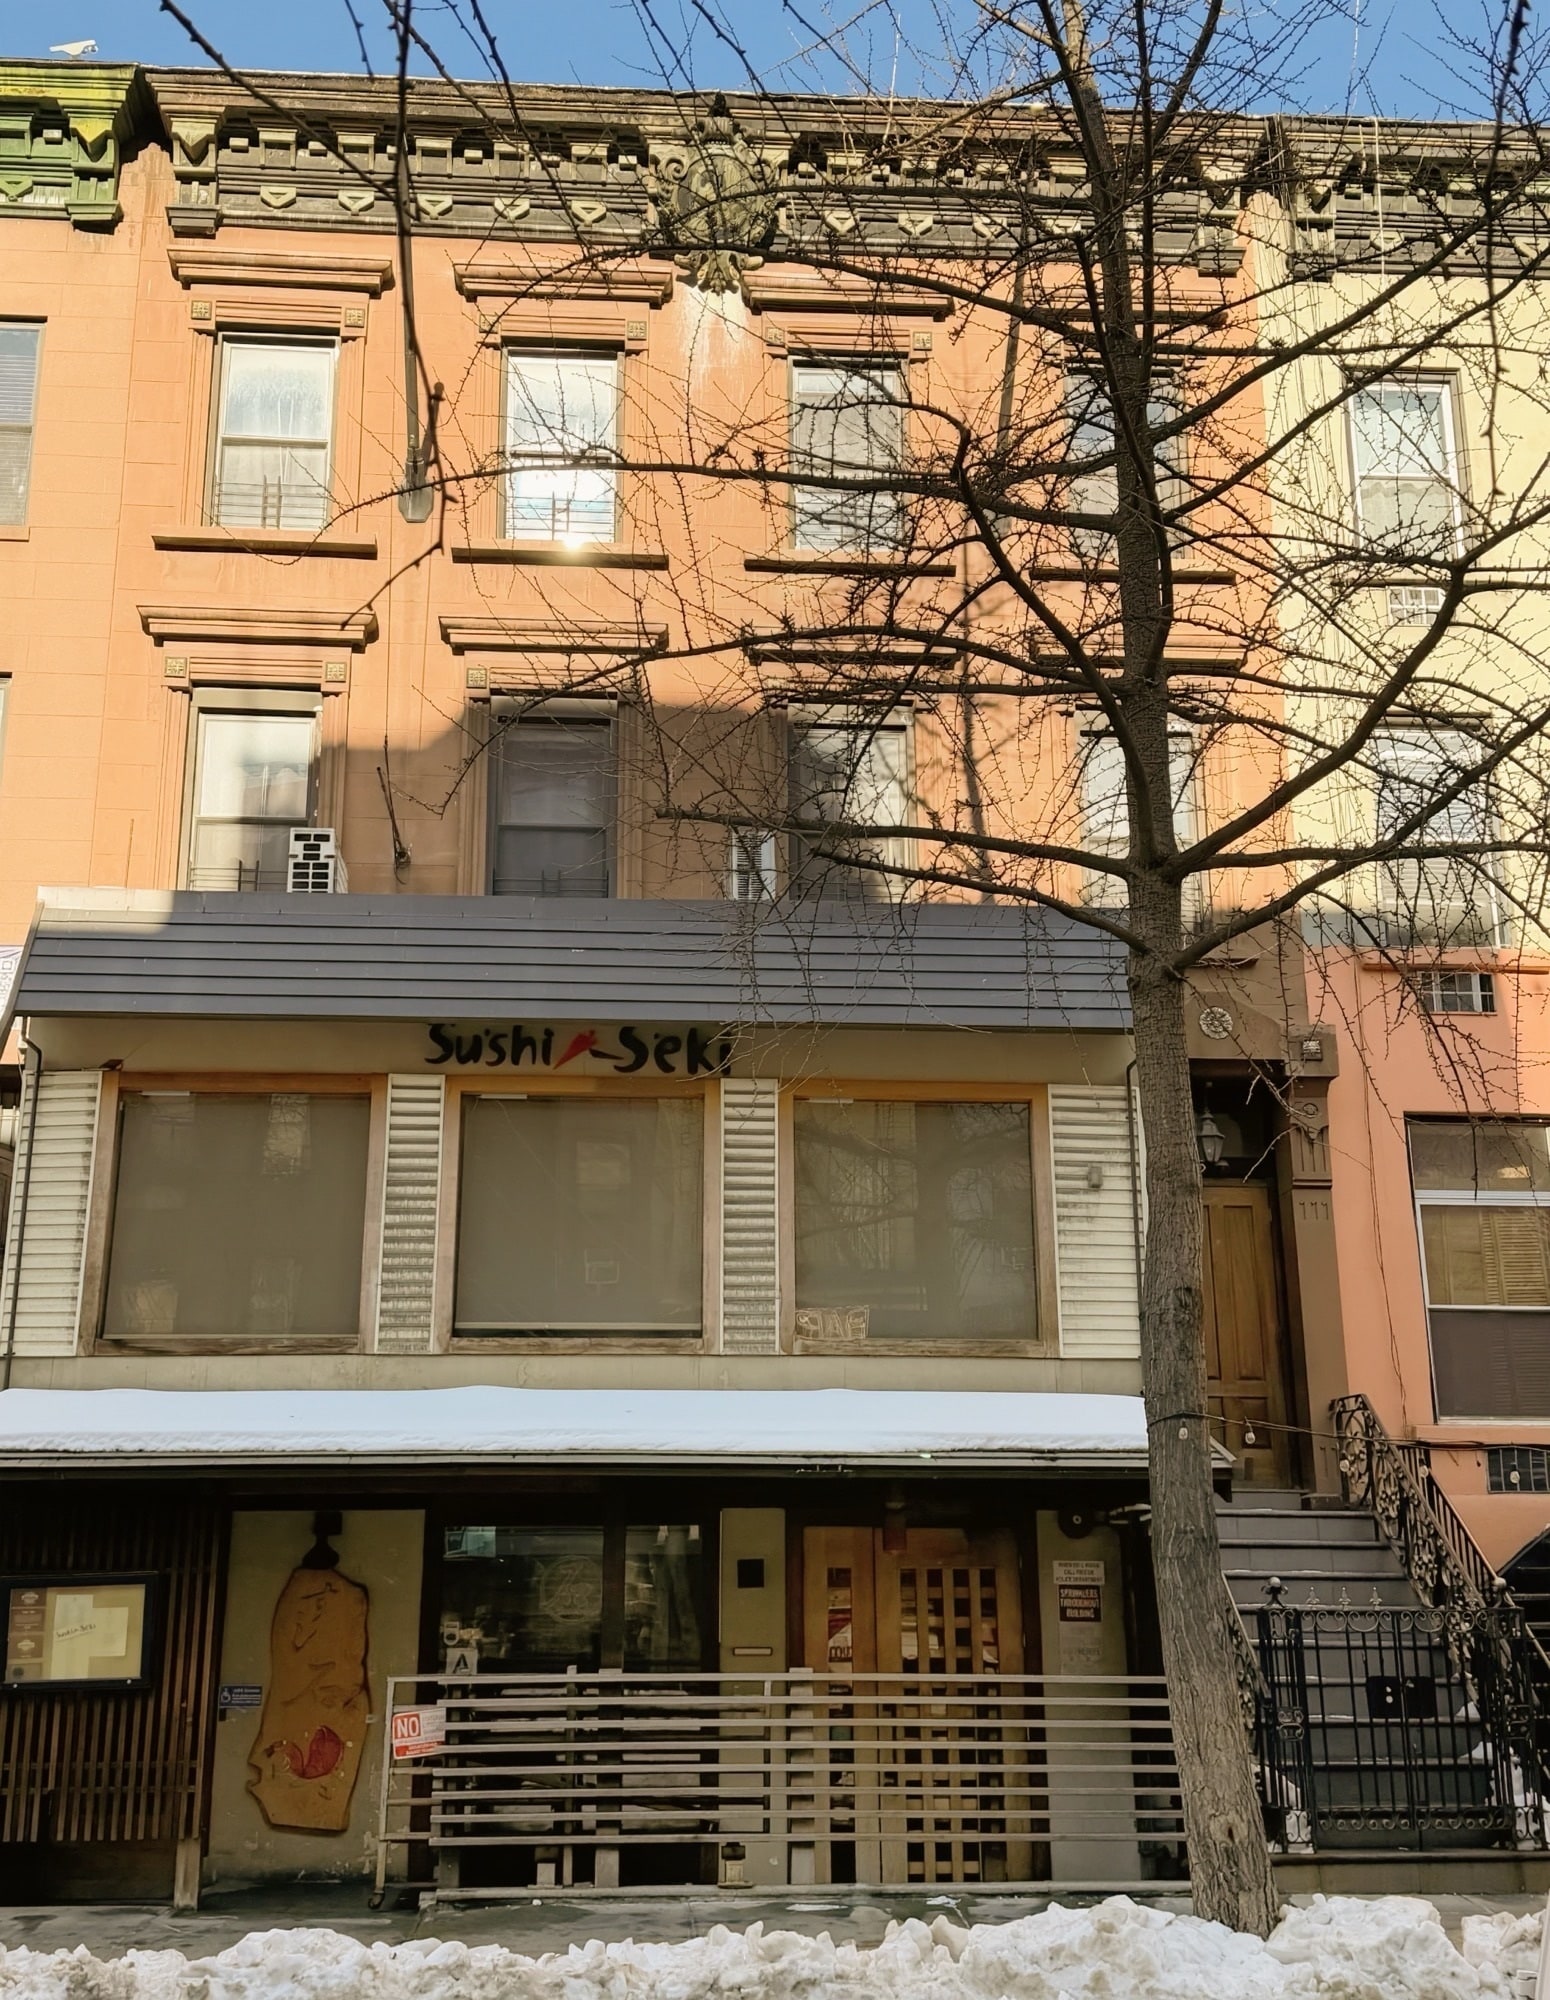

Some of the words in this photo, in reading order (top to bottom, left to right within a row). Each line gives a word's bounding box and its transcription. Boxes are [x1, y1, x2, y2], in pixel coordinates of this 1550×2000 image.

[424, 1023, 554, 1067] Sushi
[613, 1026, 732, 1075] Seki
[453, 1653, 472, 1676] A
[397, 1717, 419, 1738] NO
